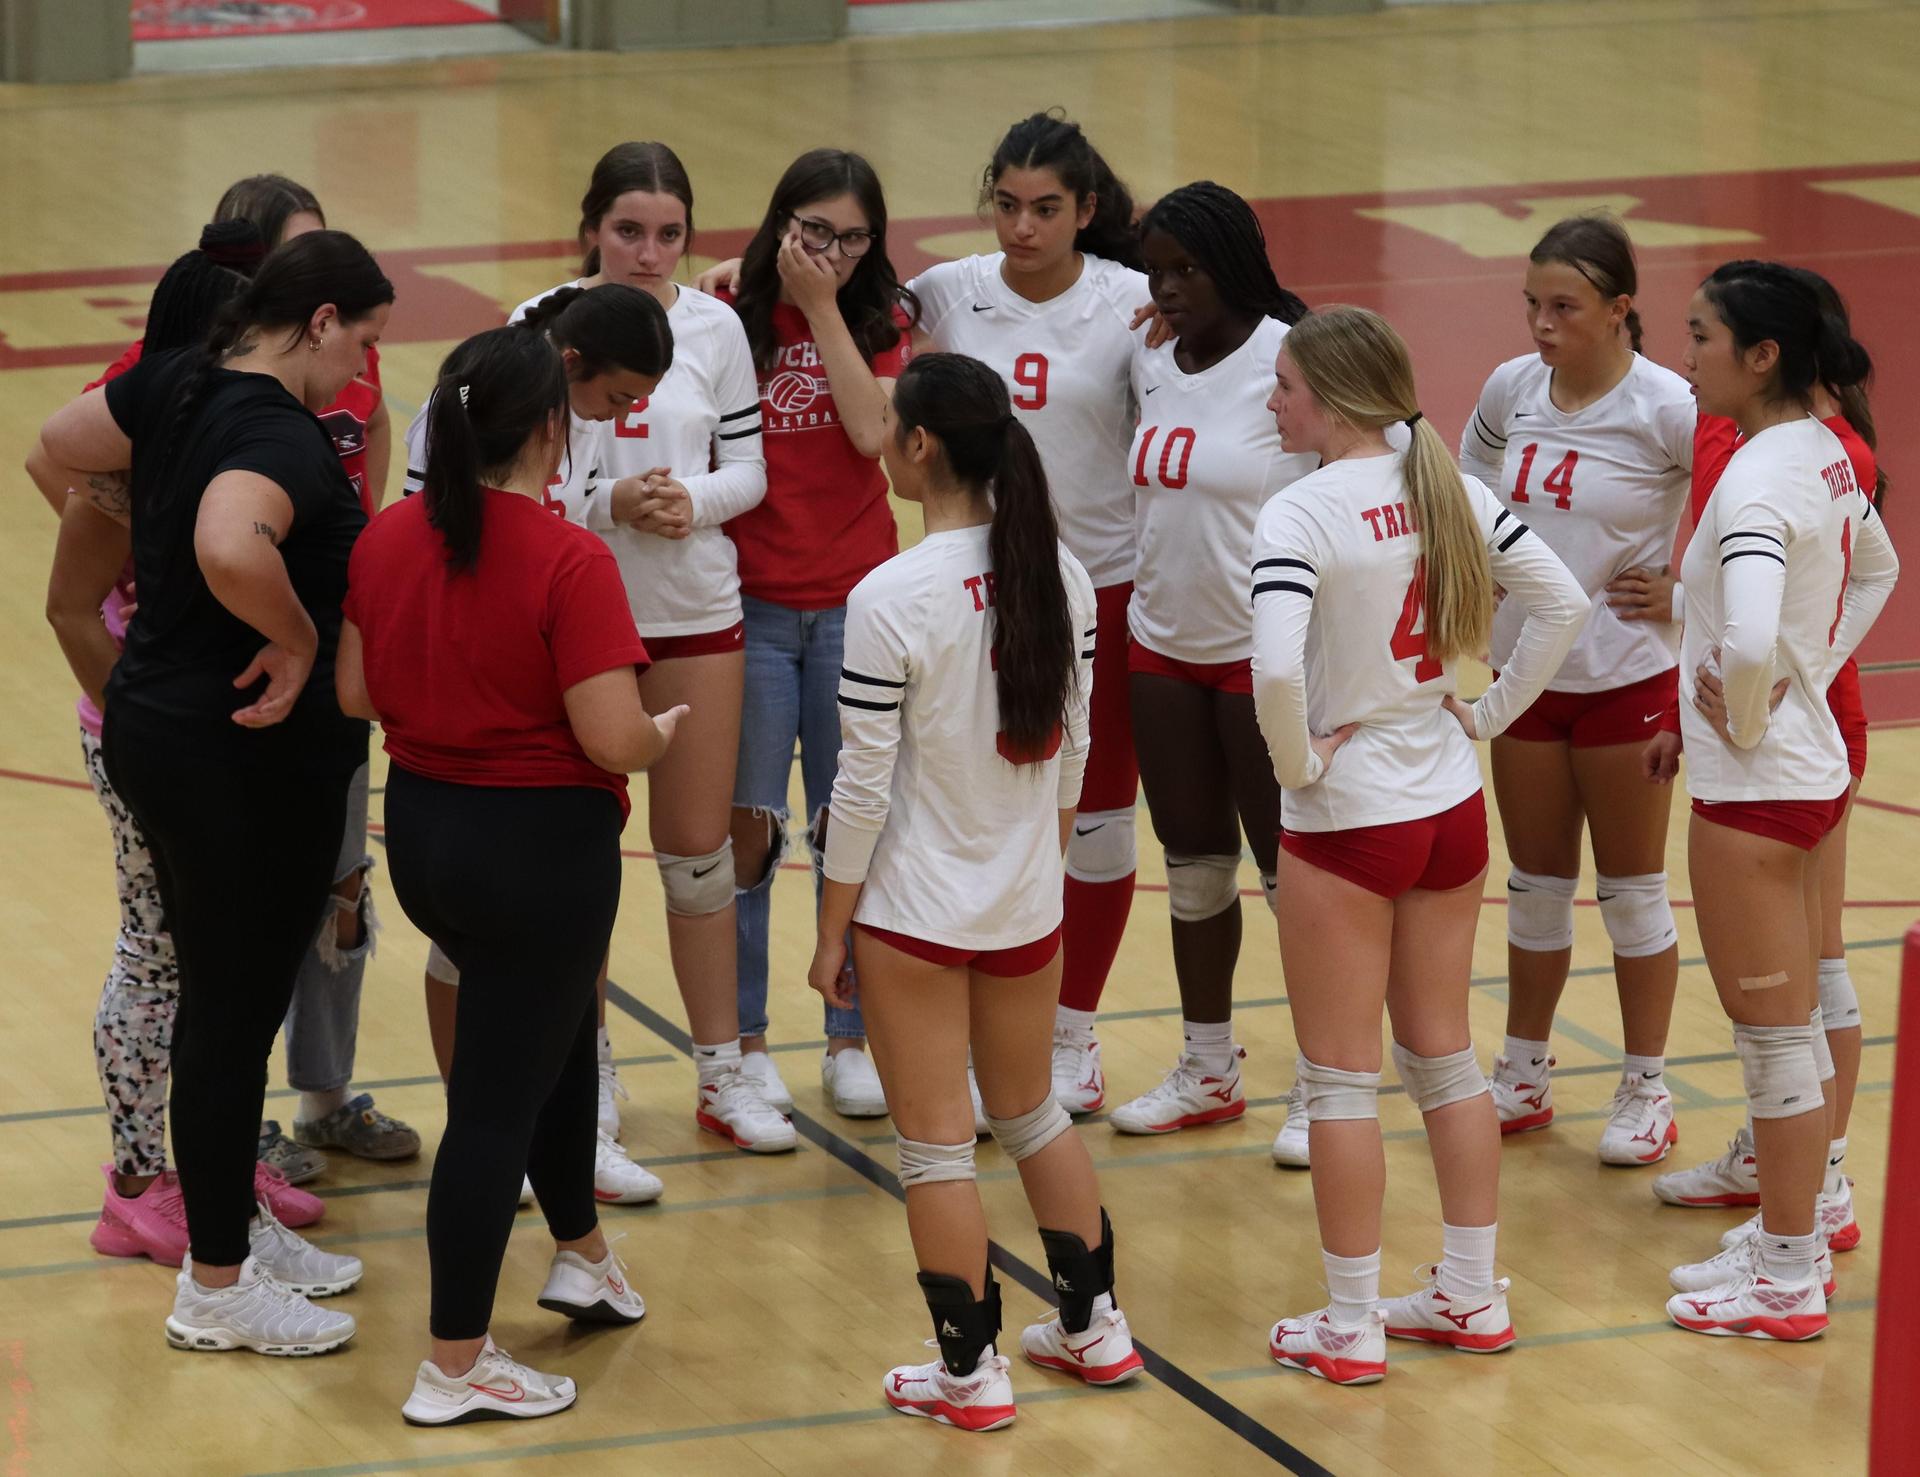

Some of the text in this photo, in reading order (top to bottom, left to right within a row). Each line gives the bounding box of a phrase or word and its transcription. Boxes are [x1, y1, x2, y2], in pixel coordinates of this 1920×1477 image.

[1013, 353, 1049, 410] 9
[1133, 426, 1196, 489] 10
[1511, 442, 1579, 511] 14
[1820, 459, 1854, 502] TRIBE
[1360, 502, 1420, 542] TRI
[1828, 515, 1852, 649] 1
[1389, 553, 1444, 684] 4
